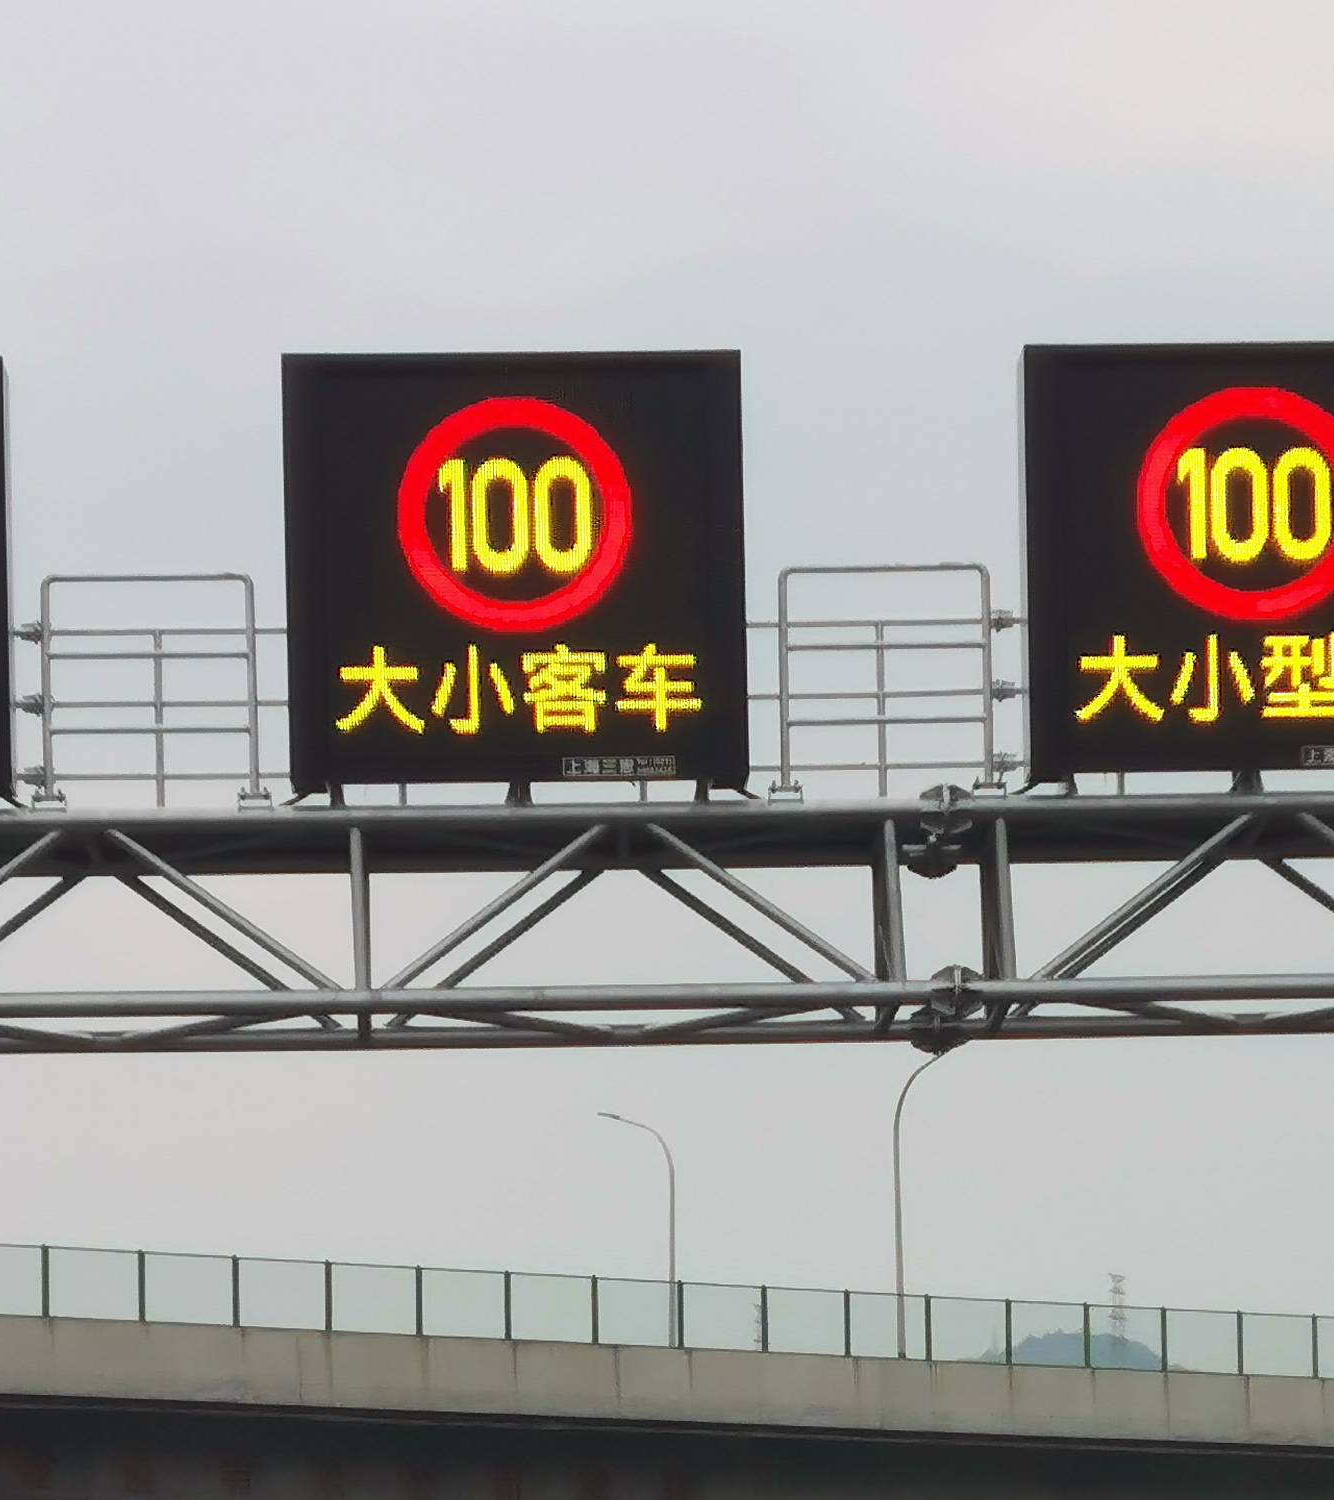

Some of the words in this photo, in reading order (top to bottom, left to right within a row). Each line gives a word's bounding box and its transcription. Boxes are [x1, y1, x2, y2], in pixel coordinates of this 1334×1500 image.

[440, 457, 593, 575] 100
[1177, 447, 1332, 564] 100
[336, 644, 703, 735] 大小客车
